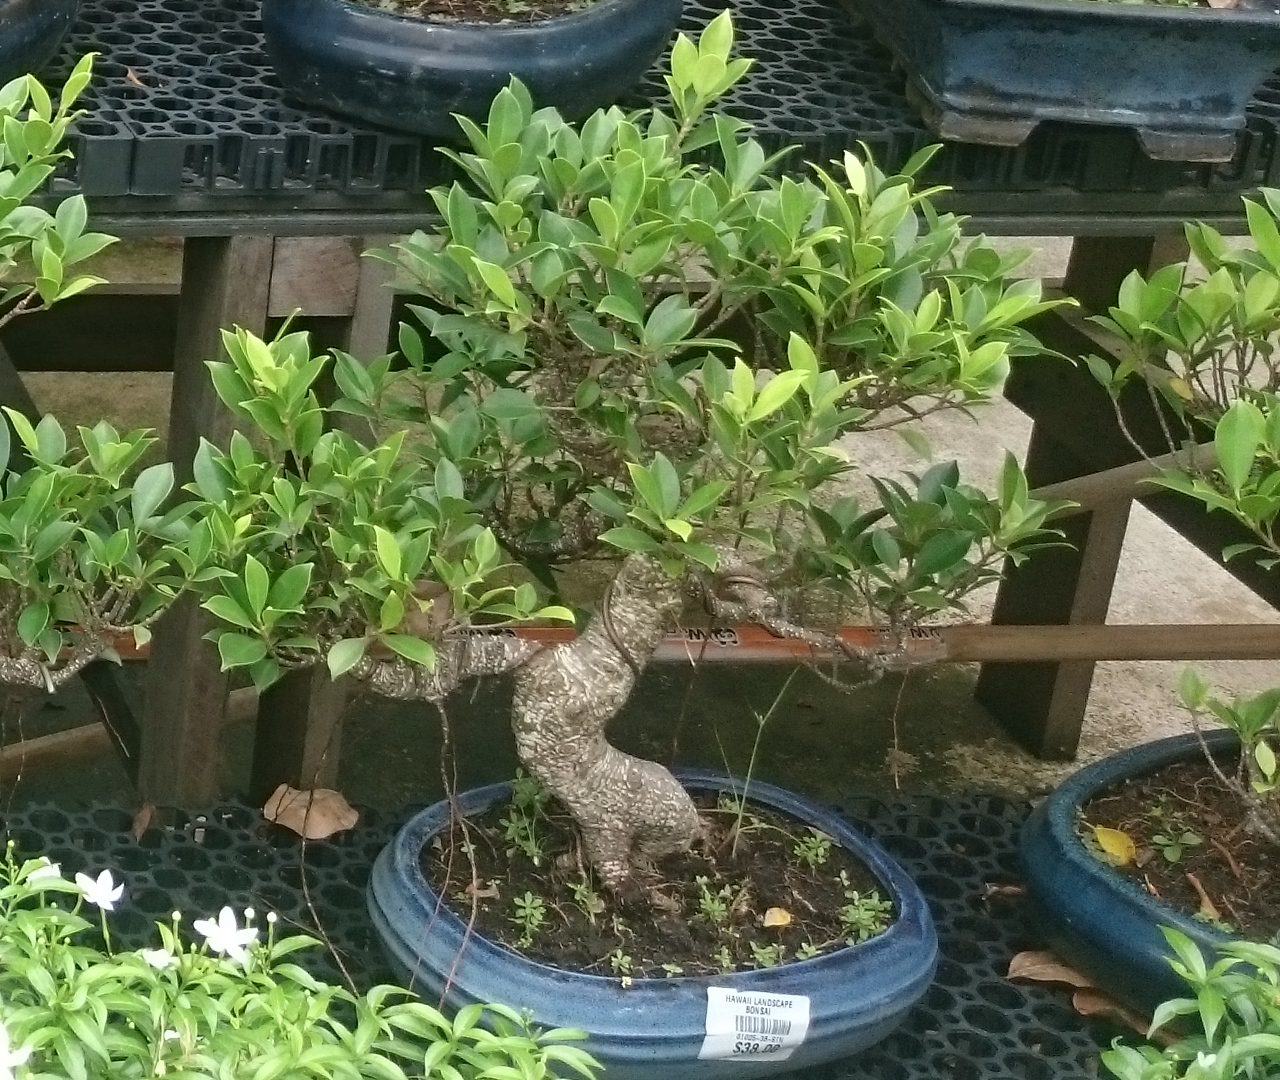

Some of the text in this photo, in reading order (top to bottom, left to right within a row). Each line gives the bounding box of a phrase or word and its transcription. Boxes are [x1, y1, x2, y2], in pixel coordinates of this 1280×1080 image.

[725, 994, 793, 1009] HAWAII LANDSCAPE
[745, 1005, 771, 1016] BONSAI
[732, 1041, 781, 1054] $38.00
